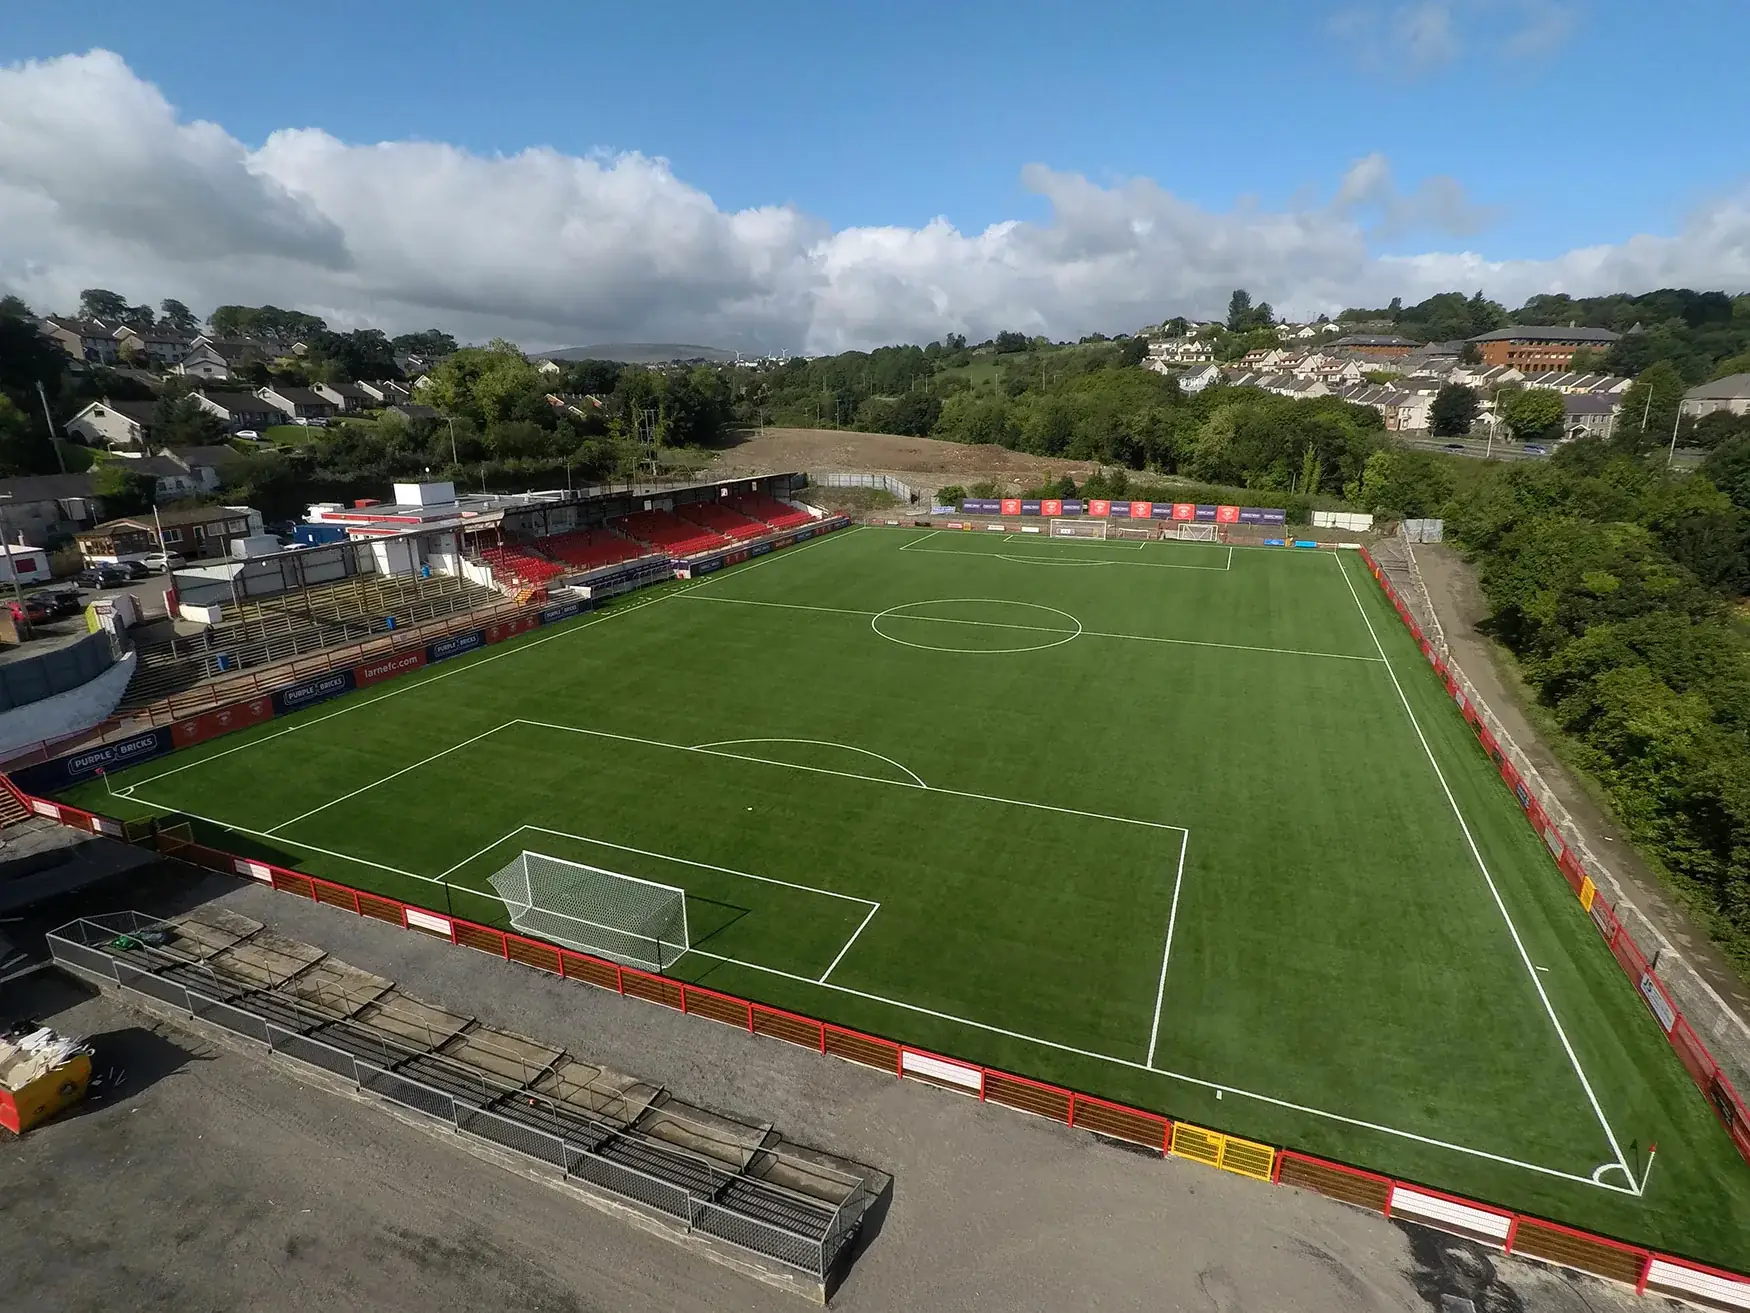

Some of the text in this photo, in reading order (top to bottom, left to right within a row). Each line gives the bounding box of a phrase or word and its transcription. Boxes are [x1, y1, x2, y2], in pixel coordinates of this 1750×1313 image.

[364, 655, 418, 678] larnefc.com
[288, 678, 343, 700] PURPLE BRICKS
[75, 738, 153, 768] PURPLE BRICKS
